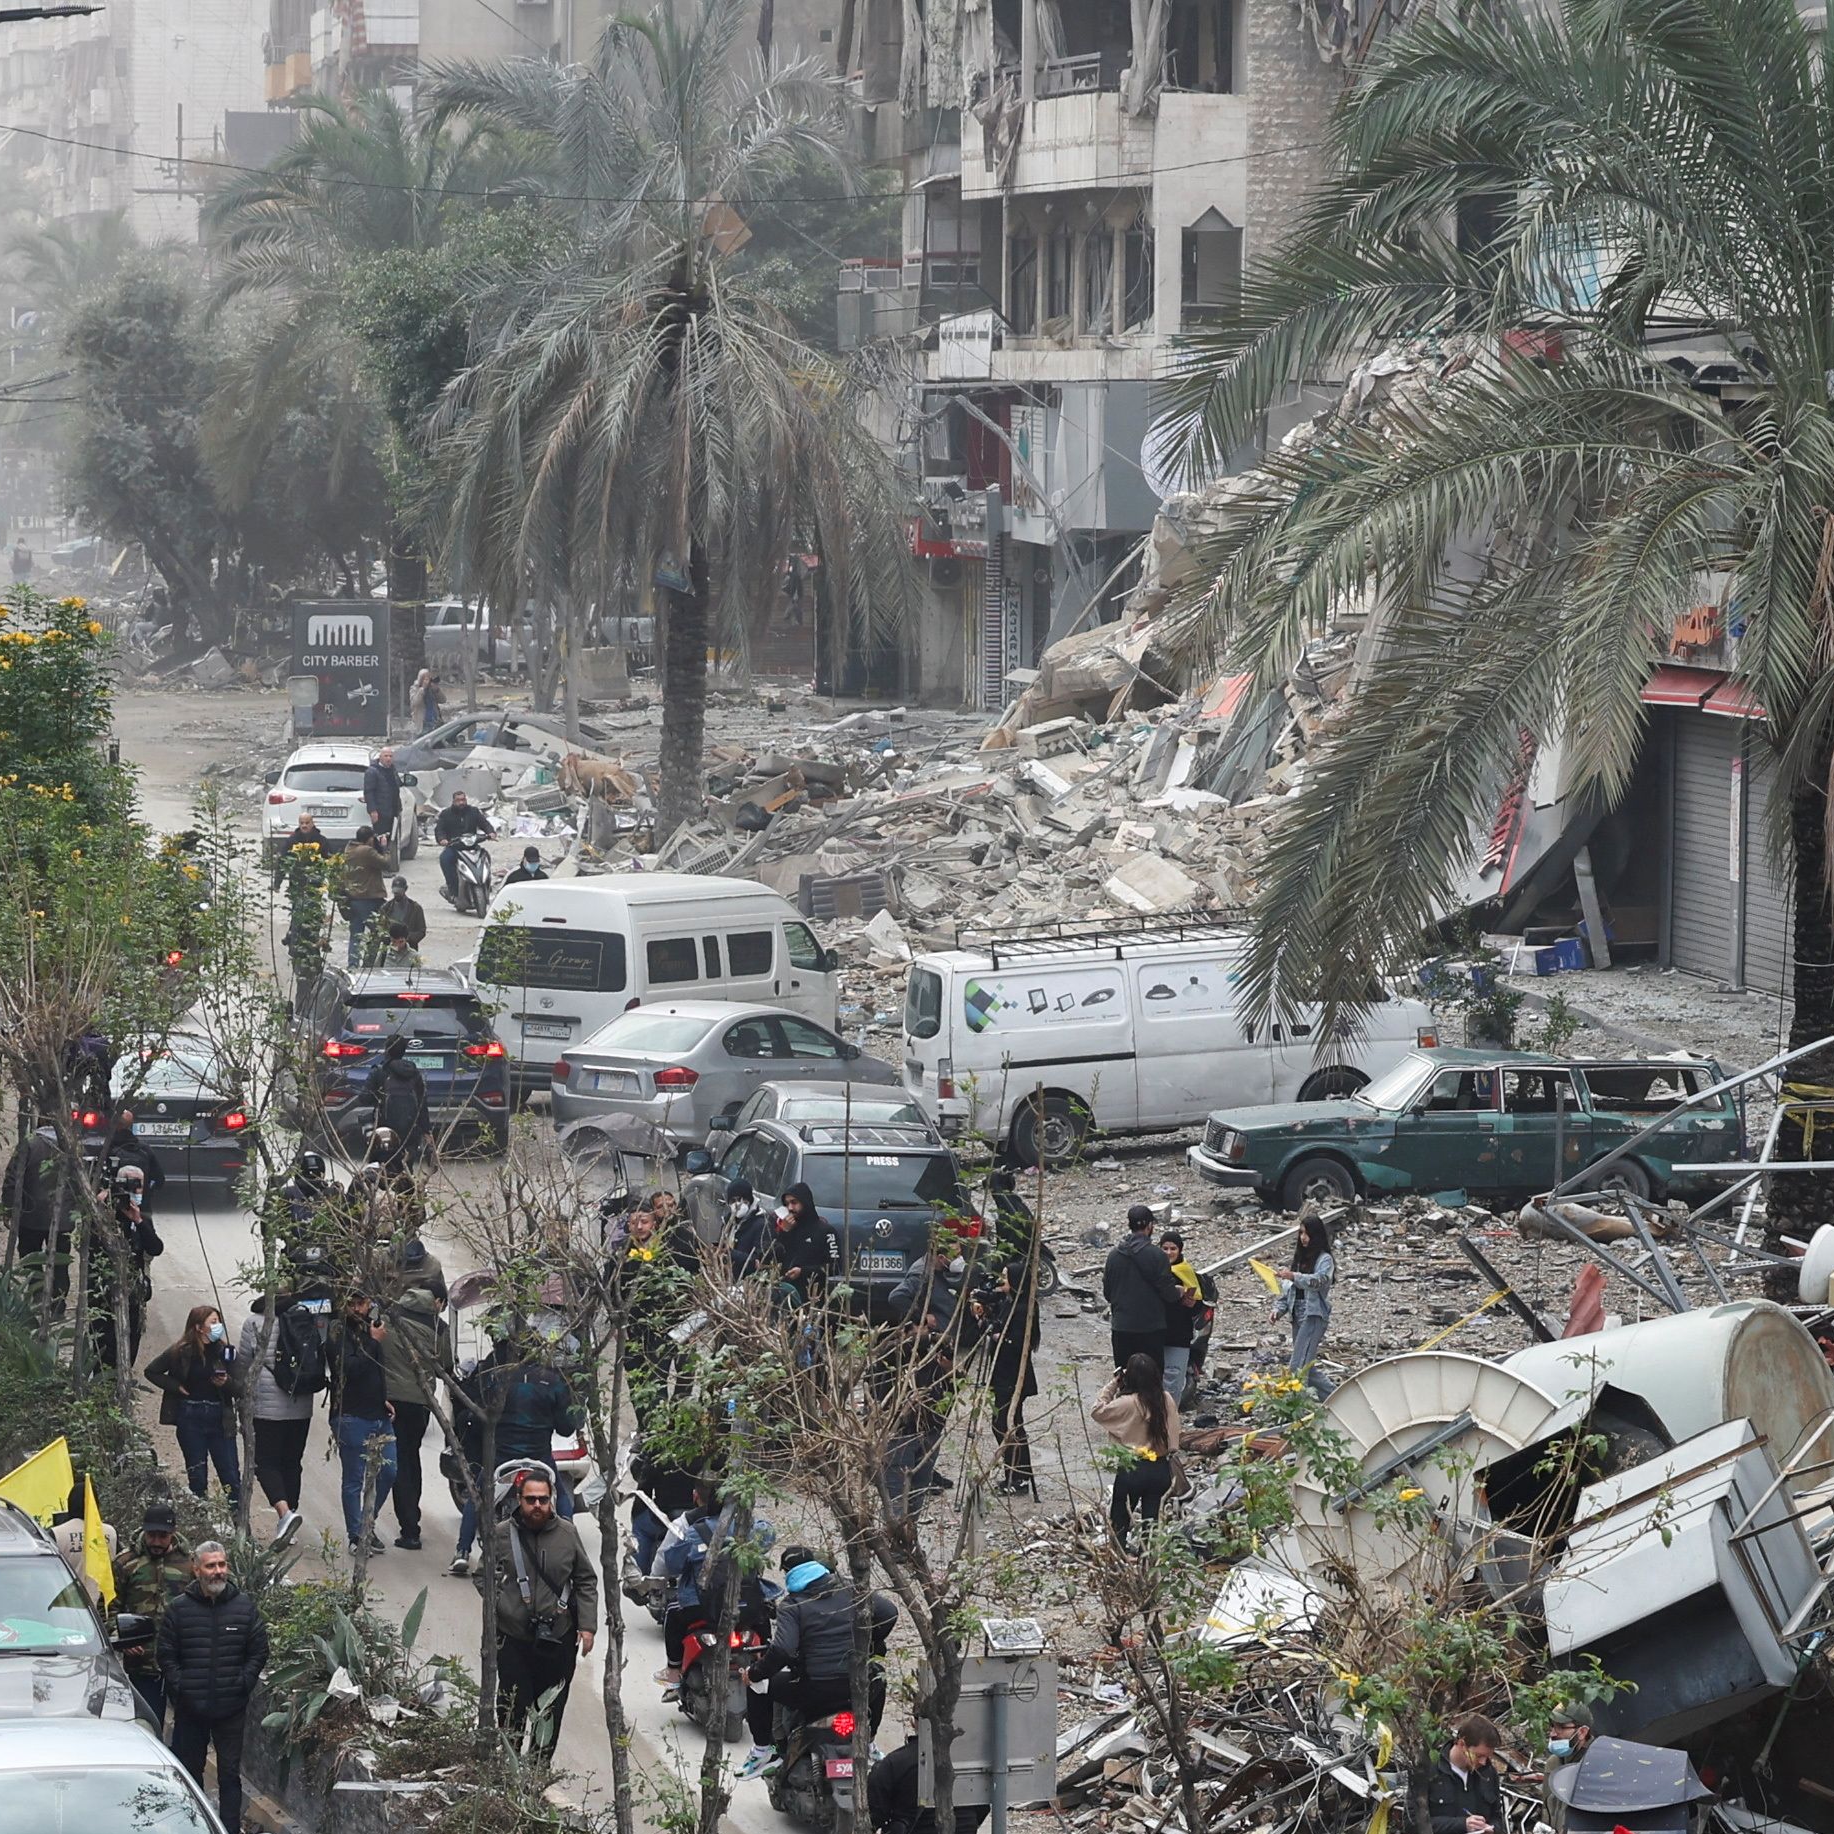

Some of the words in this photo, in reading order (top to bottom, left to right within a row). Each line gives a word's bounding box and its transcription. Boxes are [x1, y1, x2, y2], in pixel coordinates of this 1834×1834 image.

[302, 655, 328, 668] CITY
[330, 655, 380, 668] BARBER
[866, 1156, 899, 1166] PRESS
[826, 1233, 840, 1259] RUN
